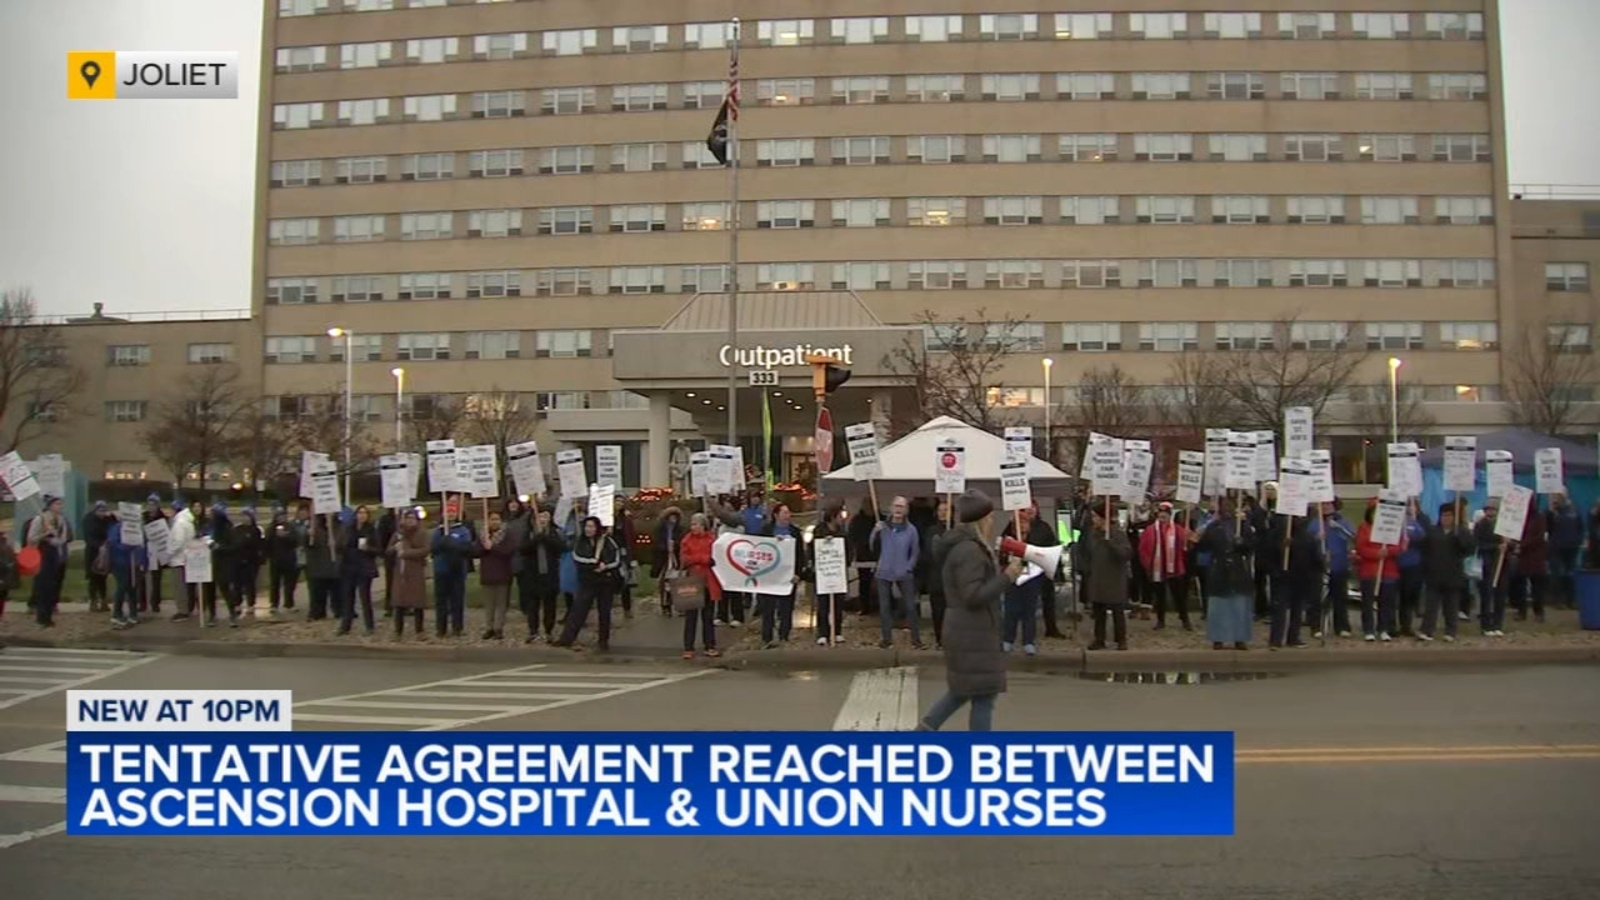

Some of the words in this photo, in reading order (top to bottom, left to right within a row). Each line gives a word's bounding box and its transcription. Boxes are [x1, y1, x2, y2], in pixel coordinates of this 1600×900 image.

[753, 372, 775, 384] 333
[853, 449, 876, 459] KILLS
[1004, 479, 1026, 487] KILLS
